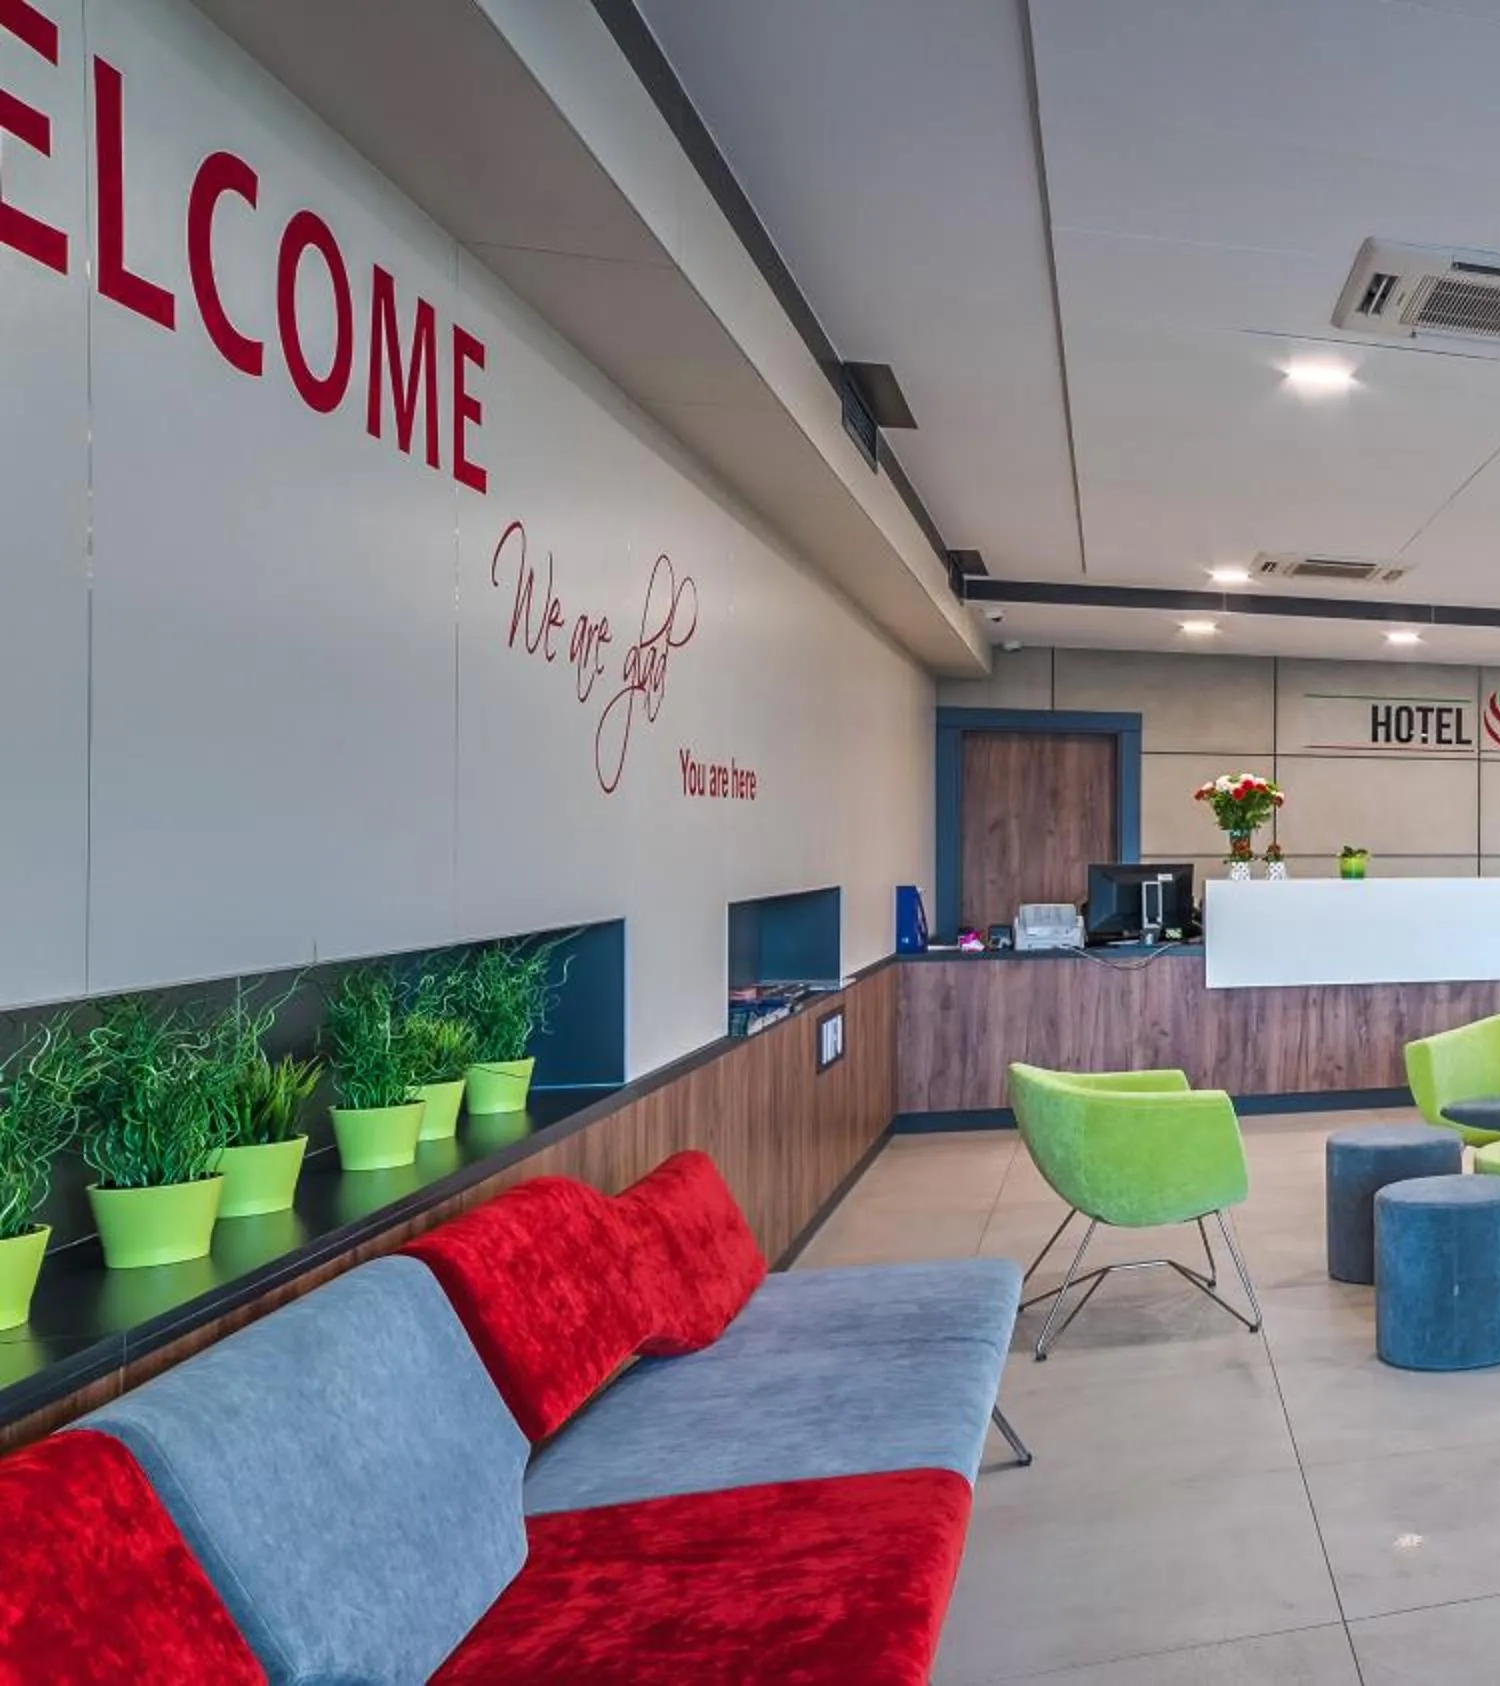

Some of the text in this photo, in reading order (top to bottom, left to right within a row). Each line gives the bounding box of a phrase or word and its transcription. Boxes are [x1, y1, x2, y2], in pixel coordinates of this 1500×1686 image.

[492, 521, 697, 793] We are glad
[1371, 704, 1472, 745] HOTEL
[680, 748, 757, 800] You are here
